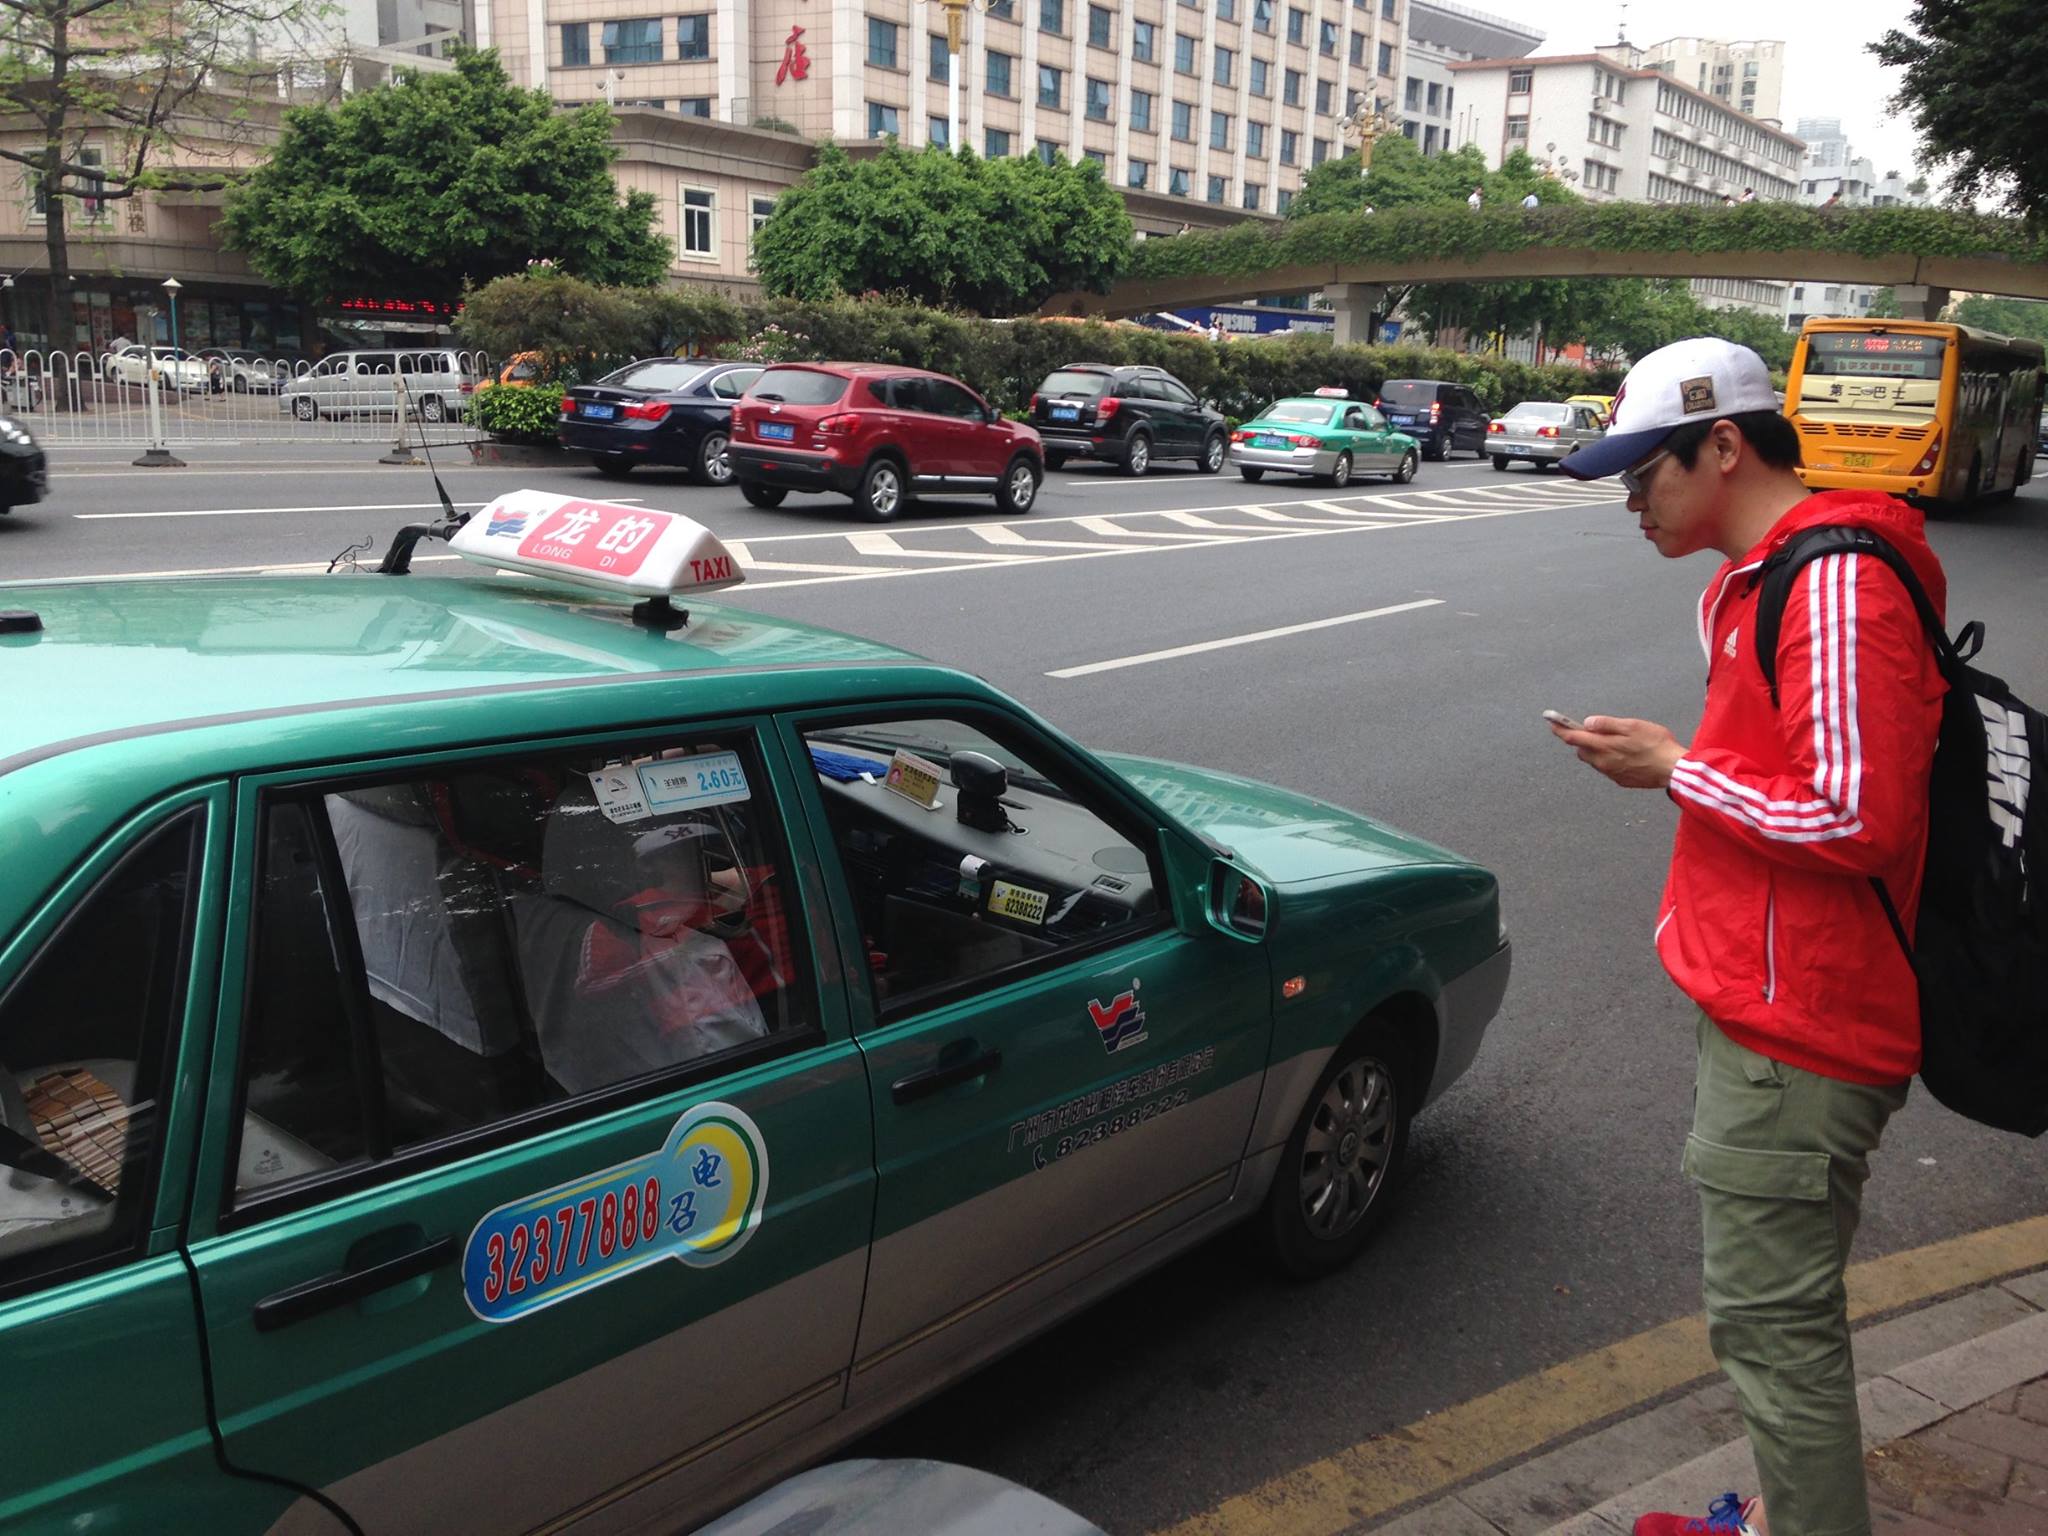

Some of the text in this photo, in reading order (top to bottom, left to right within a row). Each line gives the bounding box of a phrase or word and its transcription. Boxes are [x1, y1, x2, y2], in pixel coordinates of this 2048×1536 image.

[775, 25, 811, 87] 店
[1829, 383, 1906, 400] 第二巴士
[543, 508, 656, 554] 龙的
[530, 543, 617, 568] LONG DI
[689, 556, 732, 582] TAXI
[696, 767, 742, 791] 2.60元
[1055, 1089, 1189, 1159] 82388222
[484, 1177, 660, 1302] 32377888
